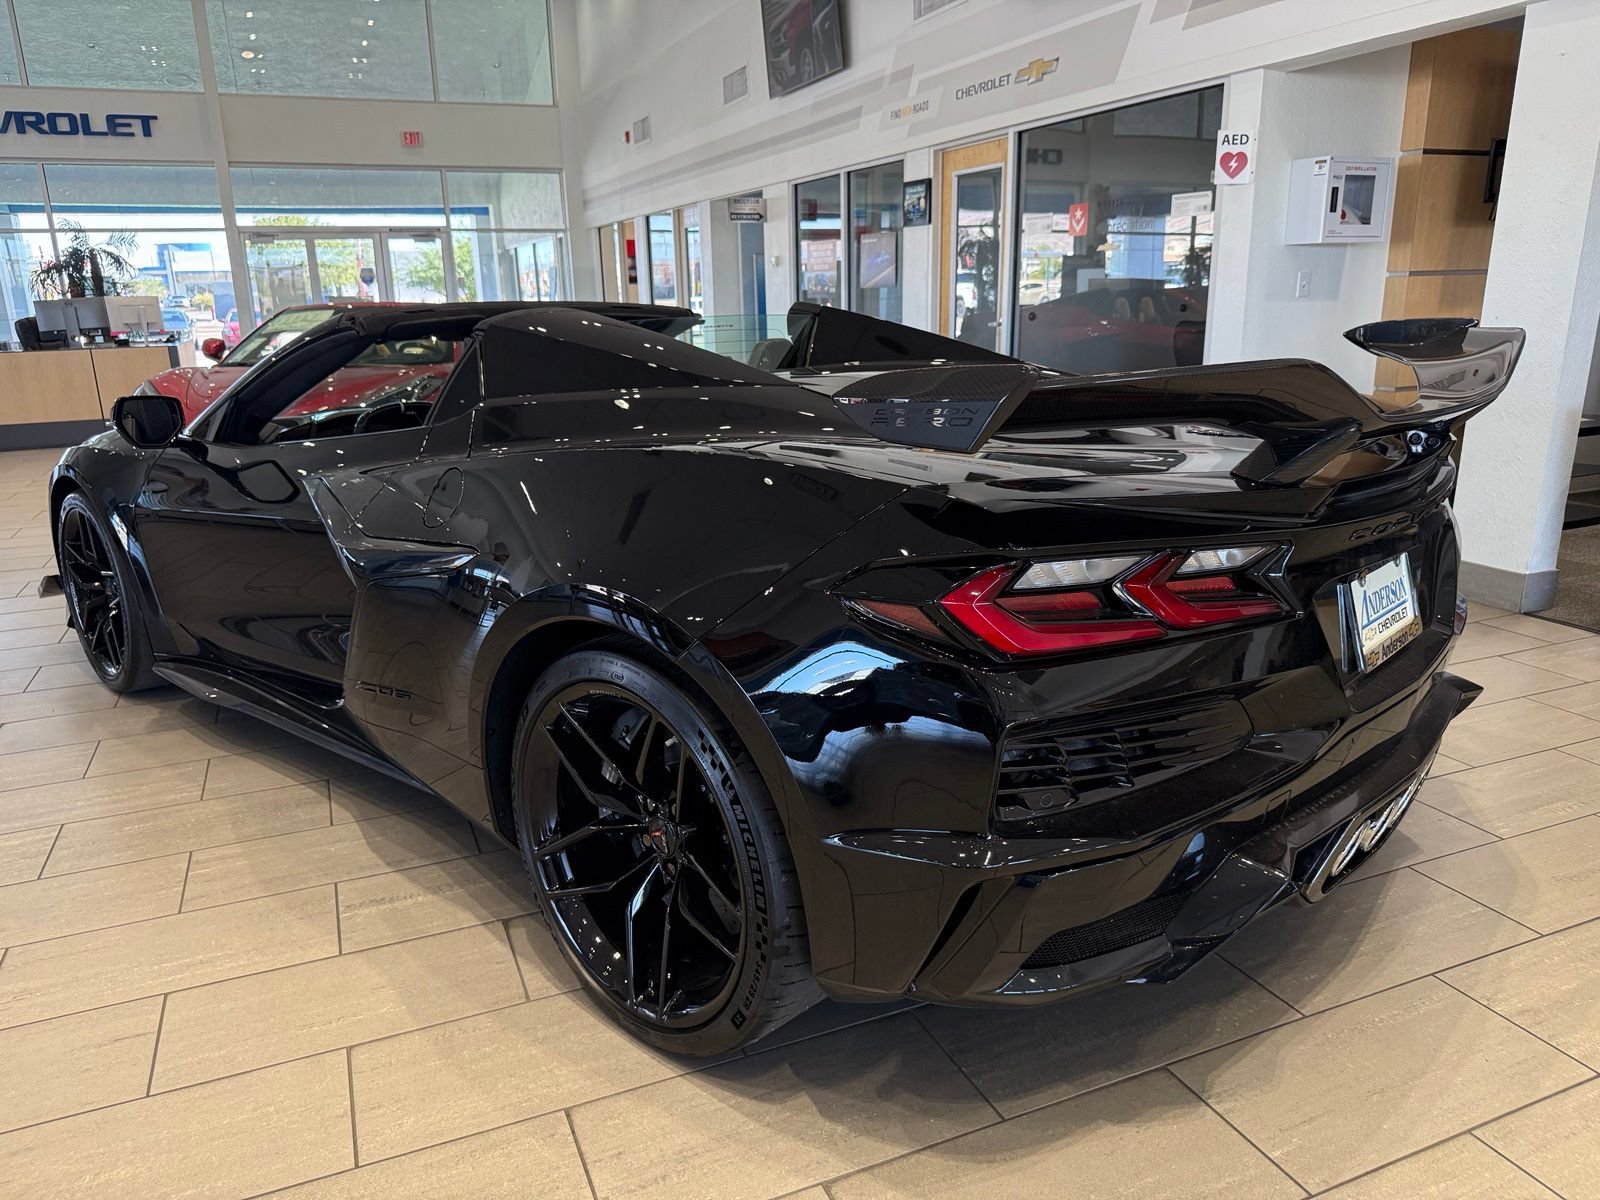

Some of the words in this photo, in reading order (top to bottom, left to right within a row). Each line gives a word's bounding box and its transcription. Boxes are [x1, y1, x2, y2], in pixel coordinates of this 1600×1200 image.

[955, 73, 1012, 101] CHEVROLET
[403, 131, 420, 145] EXIT
[1221, 134, 1249, 146] AED
[1361, 576, 1408, 625] ANDERSON
[1377, 606, 1409, 634] CHEVROLET
[1381, 631, 1409, 660] Anderson
[732, 803, 767, 913] MICHELIN
